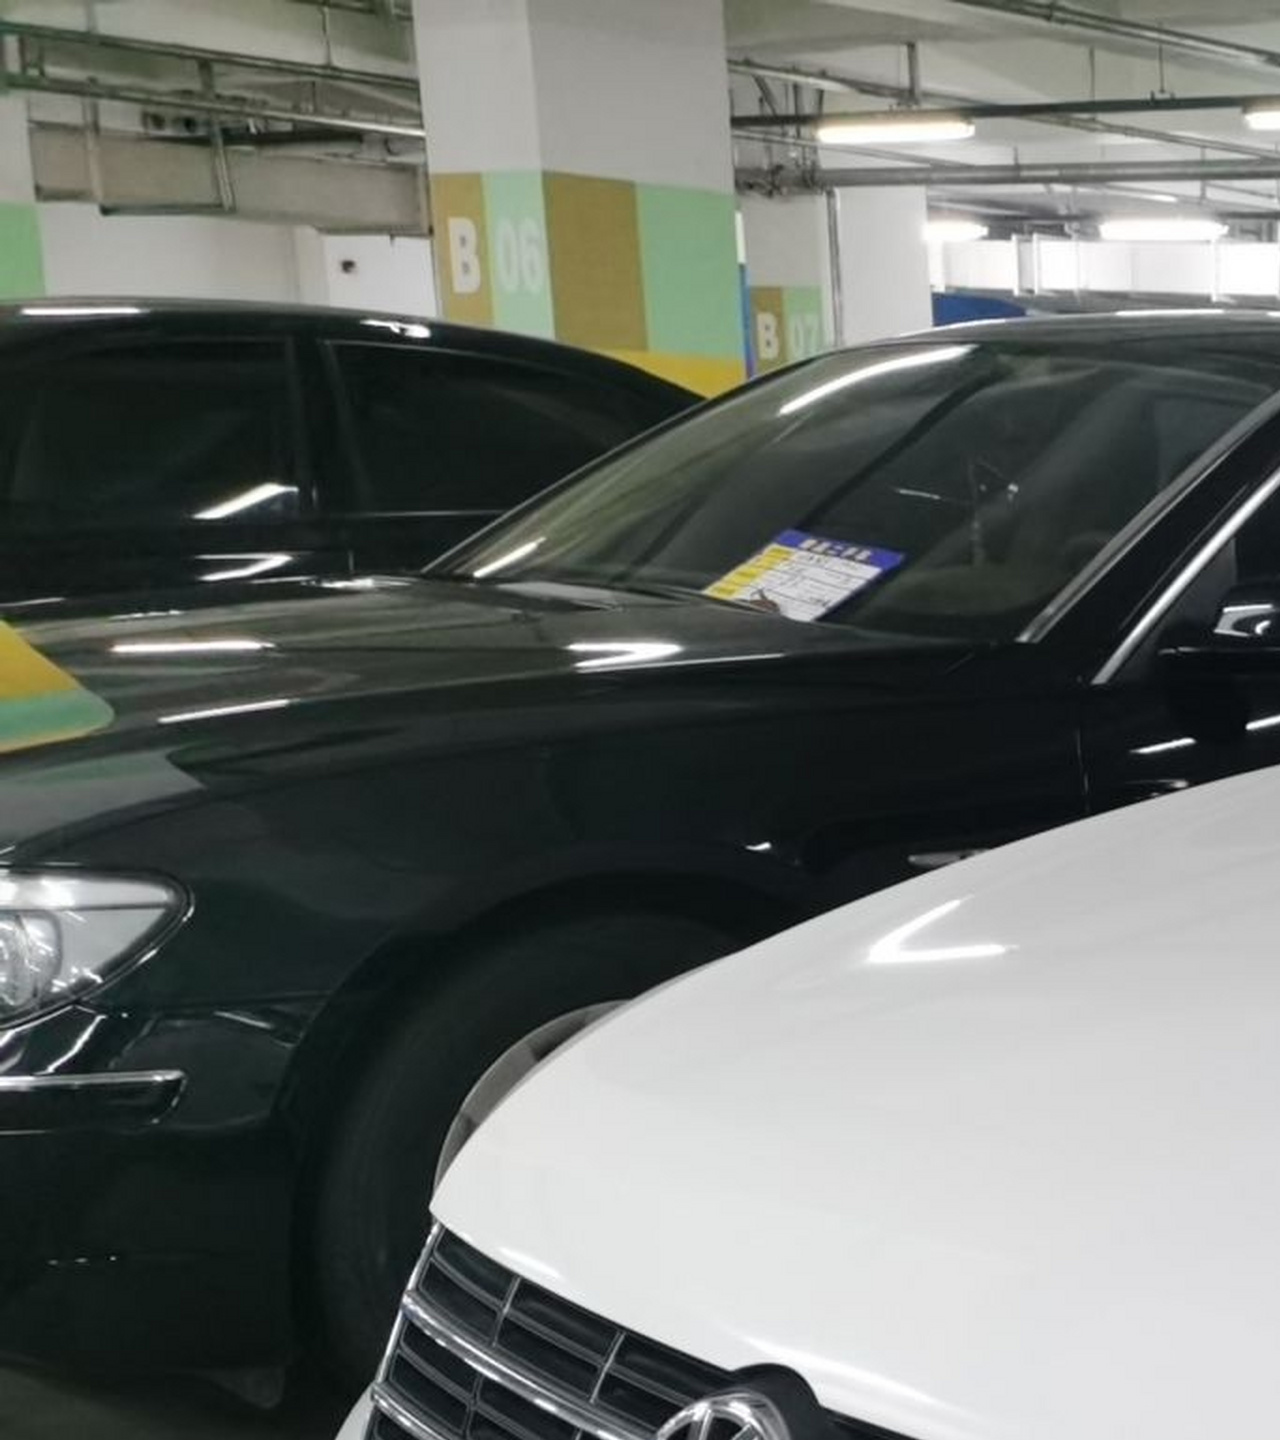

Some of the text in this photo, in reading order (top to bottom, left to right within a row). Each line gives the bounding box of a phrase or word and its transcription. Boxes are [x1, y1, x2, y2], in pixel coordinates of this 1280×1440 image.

[448, 217, 548, 294] B 06
[757, 313, 779, 358] B
